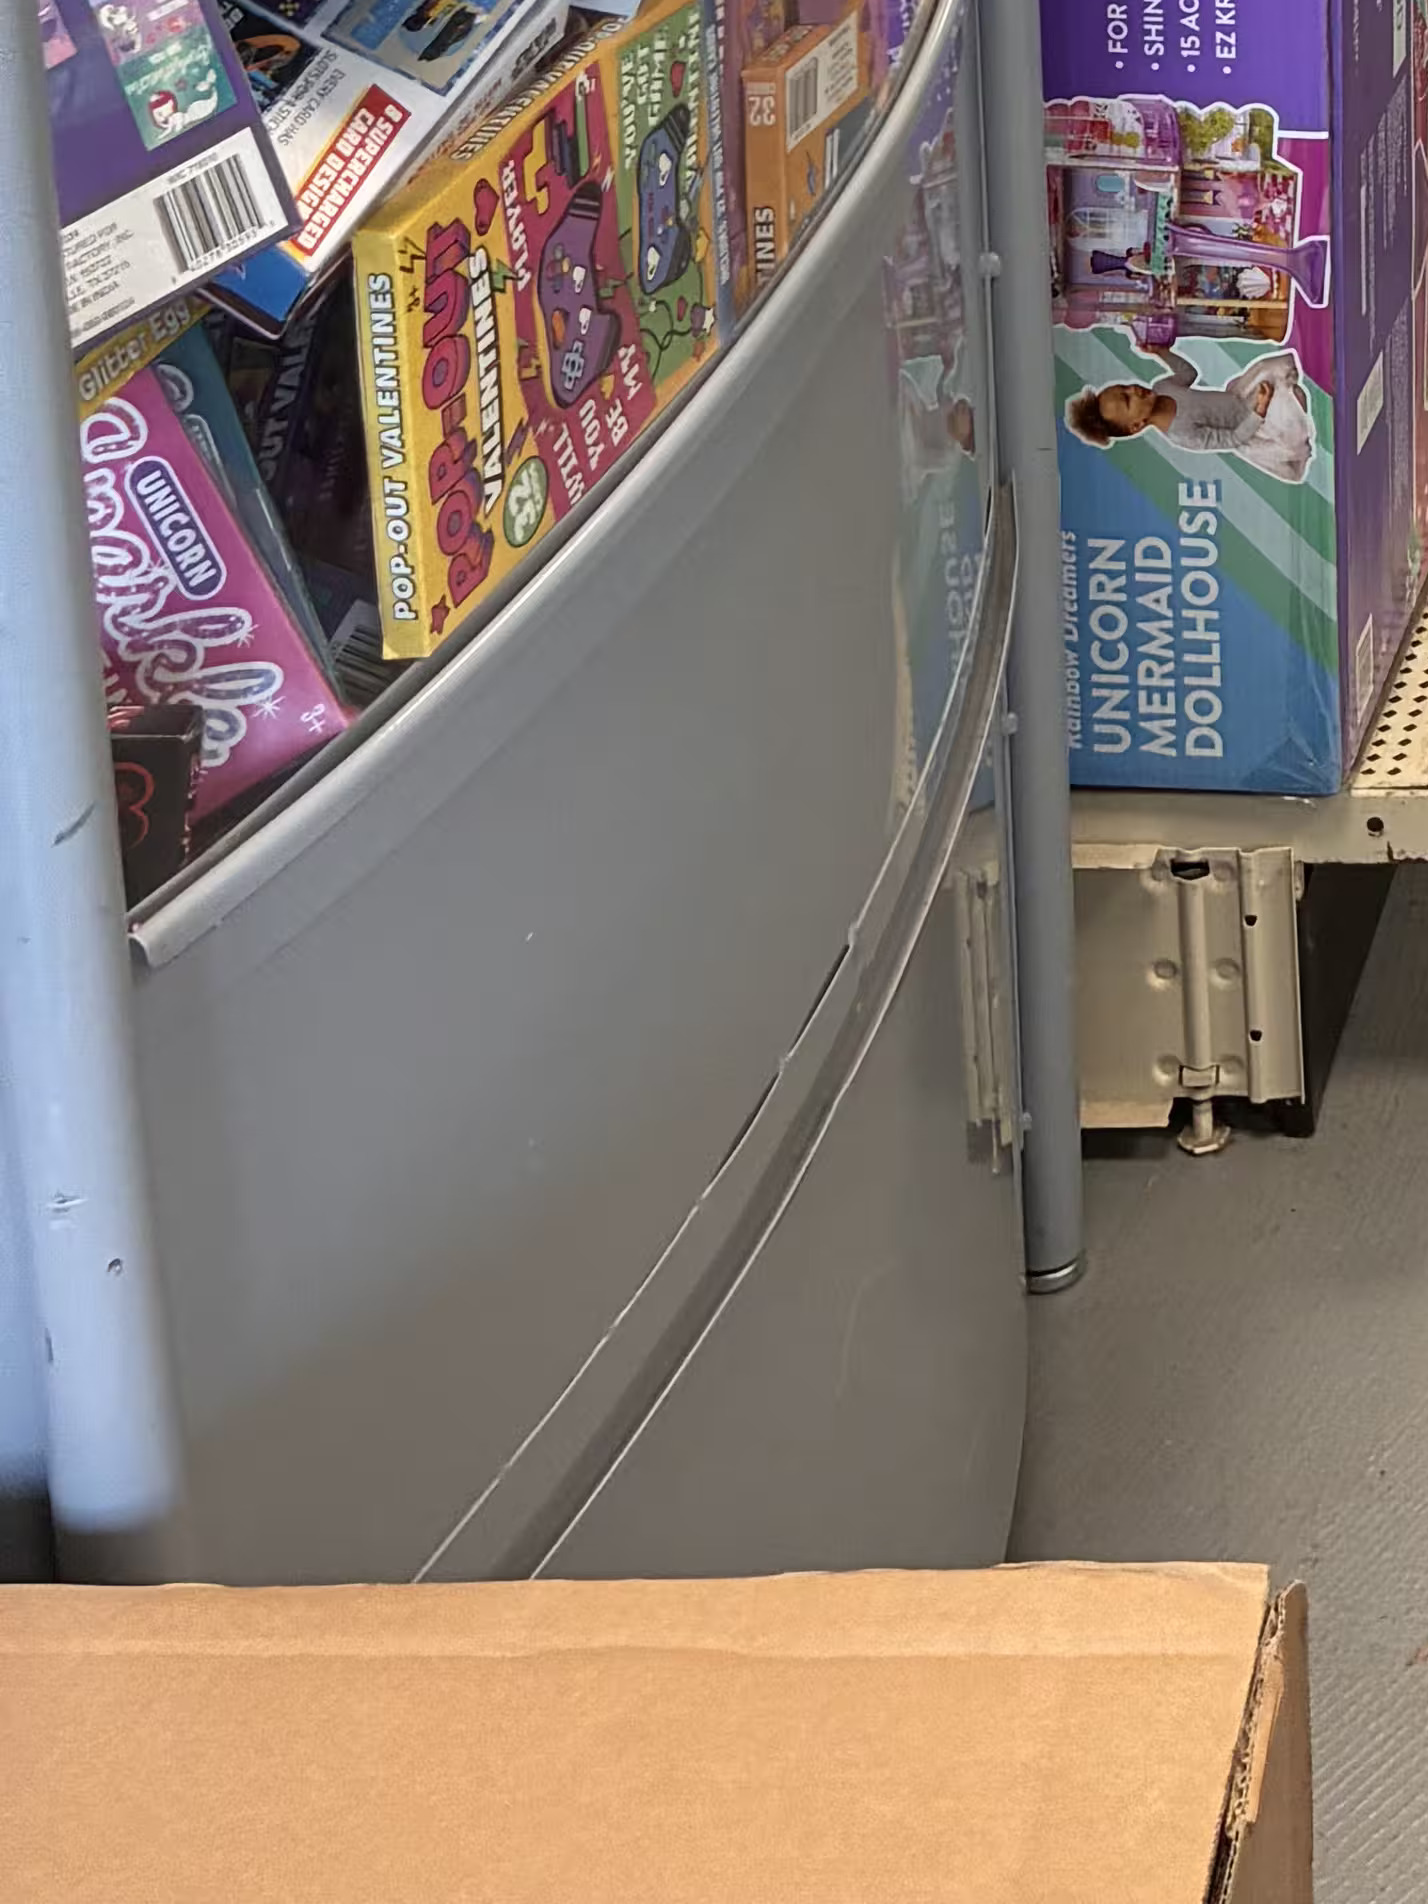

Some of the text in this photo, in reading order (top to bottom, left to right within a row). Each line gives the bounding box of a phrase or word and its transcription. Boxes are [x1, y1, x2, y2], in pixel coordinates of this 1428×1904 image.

[1107, 4, 1128, 54] FOR
[1180, 36, 1201, 58] 15
[1215, 31, 1237, 59] EZ
[338, 107, 380, 152] CARD
[451, 54, 565, 161] VALENTINES
[297, 117, 393, 255] SUPERCHARGED
[502, 160, 531, 290] PLAYER
[77, 300, 192, 401] Glitter Egg
[469, 247, 503, 514] VALENTINES
[619, 343, 644, 399] MY
[368, 271, 418, 622] POP-OUT VALENTINES
[421, 219, 495, 610] POP-OUT
[556, 422, 583, 506] WILL
[579, 399, 604, 469] YOU
[604, 405, 628, 448] BE
[134, 469, 217, 590] UNICORN
[1060, 530, 1080, 642] Dreamers
[1178, 482, 1223, 758] DOLLHOUSE
[1087, 537, 1132, 754] UNICORN
[1134, 536, 1177, 757] MERMAID
[301, 704, 327, 734] 3+
